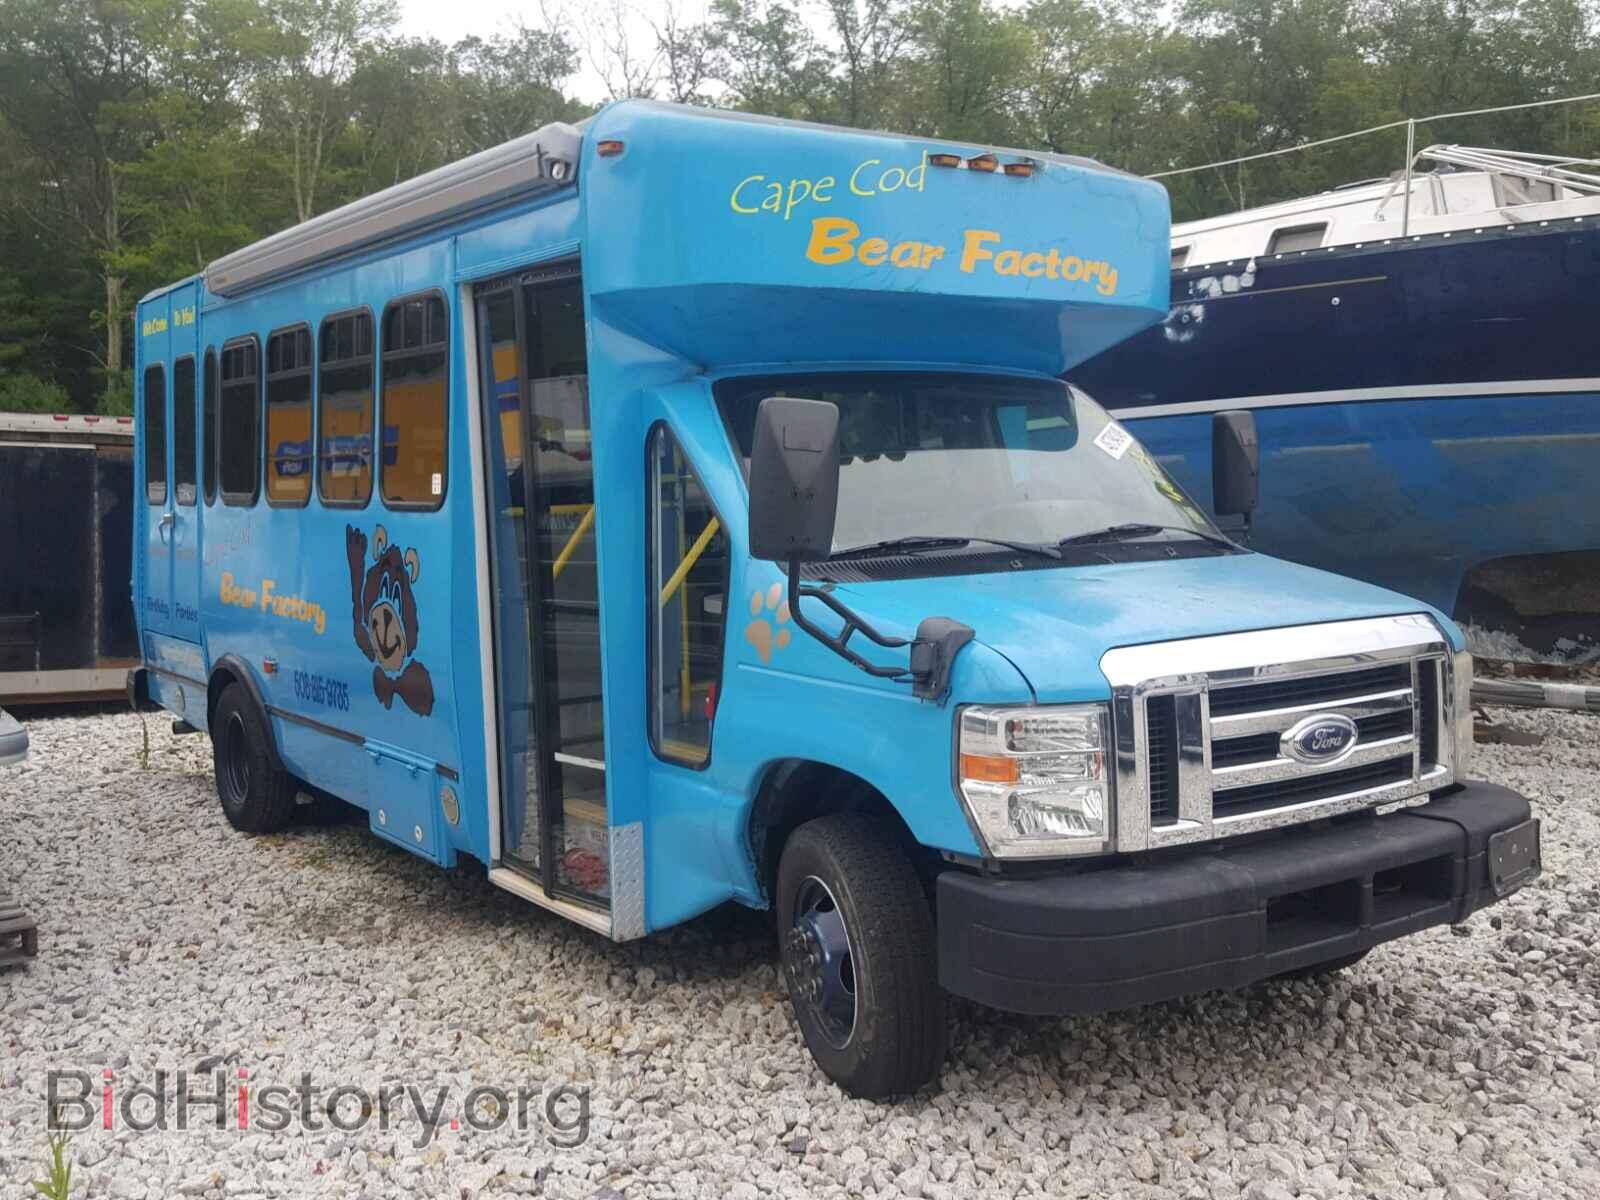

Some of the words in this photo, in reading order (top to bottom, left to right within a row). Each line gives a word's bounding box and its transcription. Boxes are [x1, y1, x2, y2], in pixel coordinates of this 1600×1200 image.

[730, 174, 835, 220] Cape
[849, 150, 928, 197] Cod
[806, 217, 945, 272] Bear
[959, 229, 1119, 297] Factory
[220, 571, 256, 609] Bear
[262, 579, 325, 634] Factory
[1312, 727, 1342, 750] Ford
